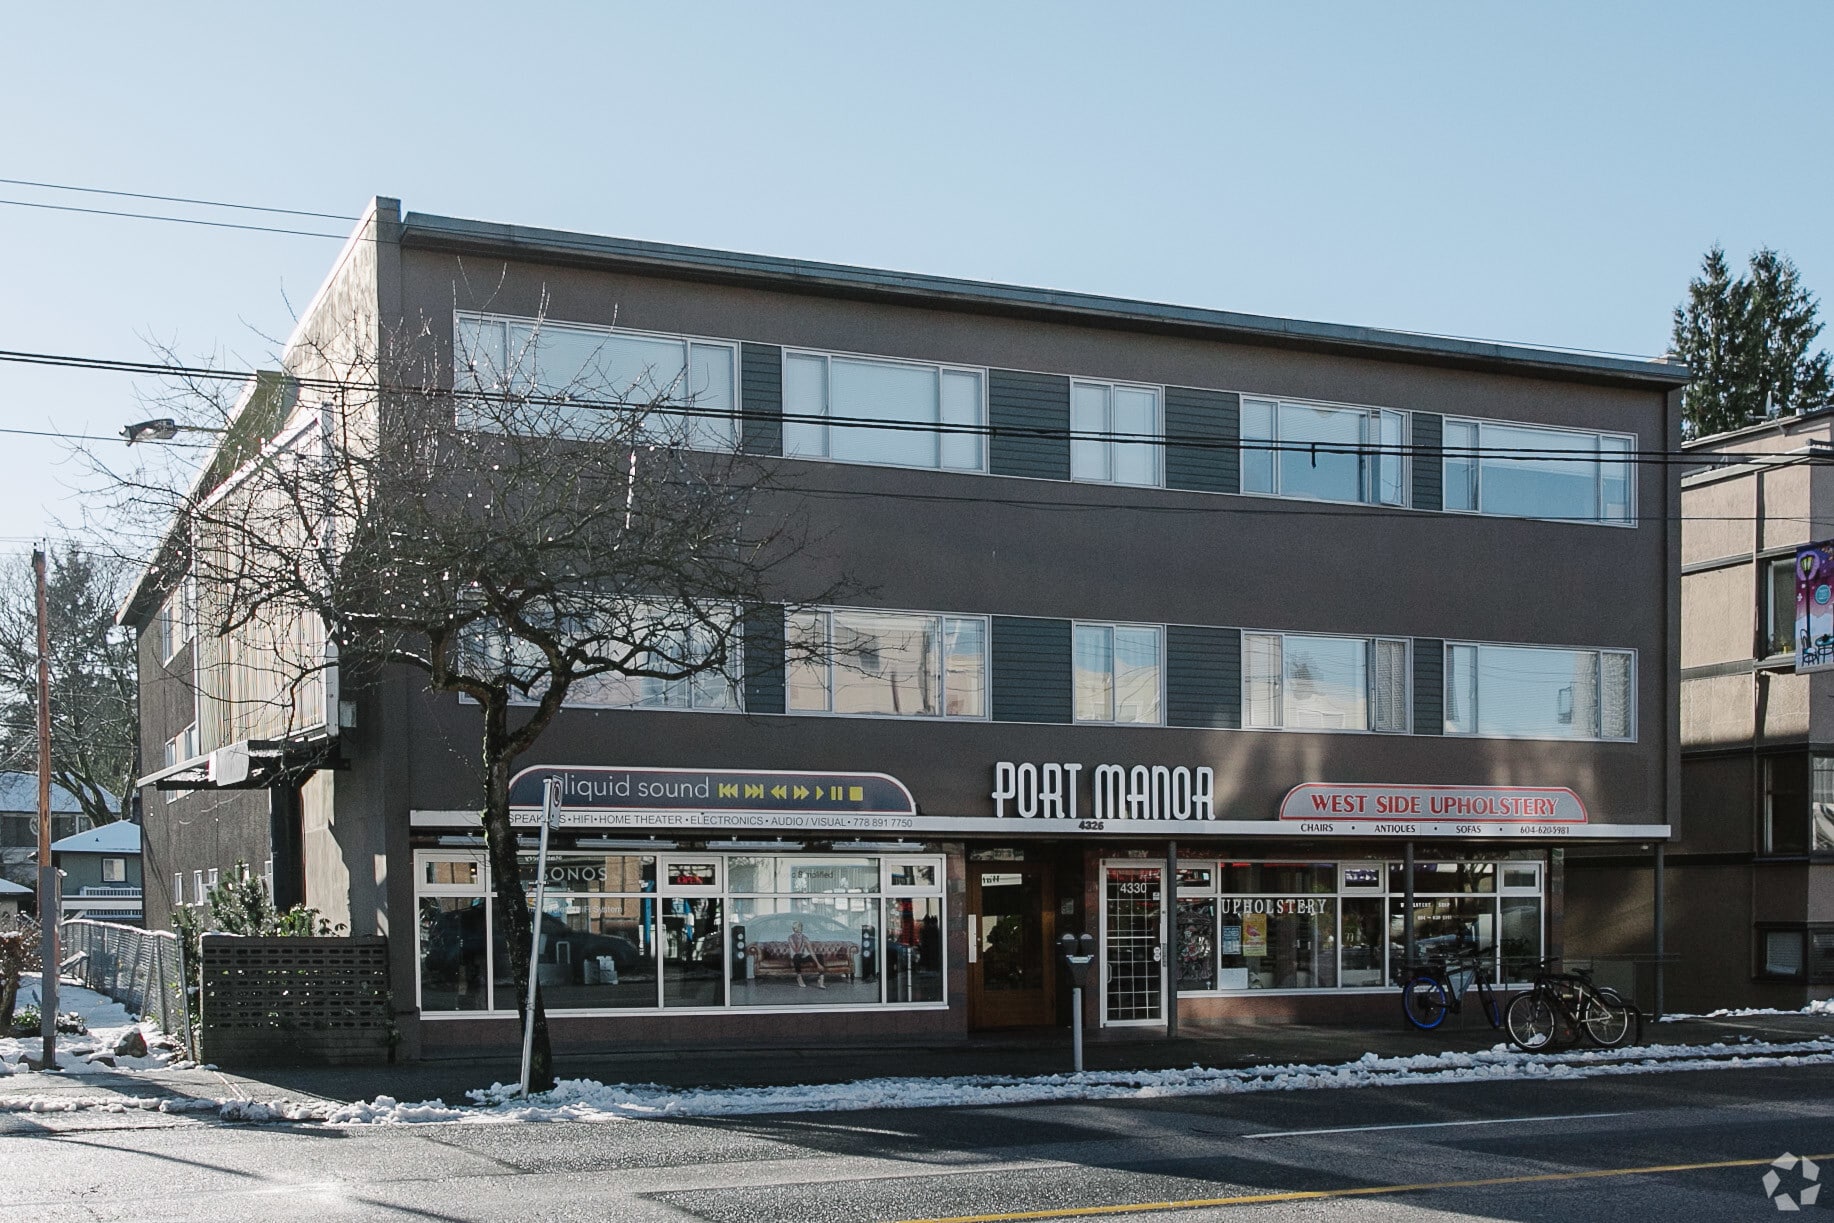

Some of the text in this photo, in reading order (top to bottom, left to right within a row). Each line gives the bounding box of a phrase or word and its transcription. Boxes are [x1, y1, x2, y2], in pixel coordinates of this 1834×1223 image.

[564, 772, 709, 802] liquid sound
[991, 761, 1216, 821] PORT MANOR
[1311, 794, 1559, 816] WEST SIDE UPHOLSTERY
[508, 814, 566, 824] SPEAKS
[599, 815, 631, 825] HOME
[634, 815, 683, 825] THEATER
[690, 816, 763, 825] ELECTRONICS
[771, 817, 804, 826] AUDIO
[812, 817, 846, 827] VISUAL
[853, 817, 870, 827] 778
[872, 818, 888, 827] 891
[891, 818, 913, 828] 7750
[1078, 821, 1105, 831] 4326
[1300, 823, 1334, 833] CHAIRS
[1374, 824, 1416, 834] ANTIQUES
[1455, 825, 1482, 834] SOFAS
[1120, 882, 1147, 893] 4330
[1221, 899, 1327, 914] UPHOLSTERY
